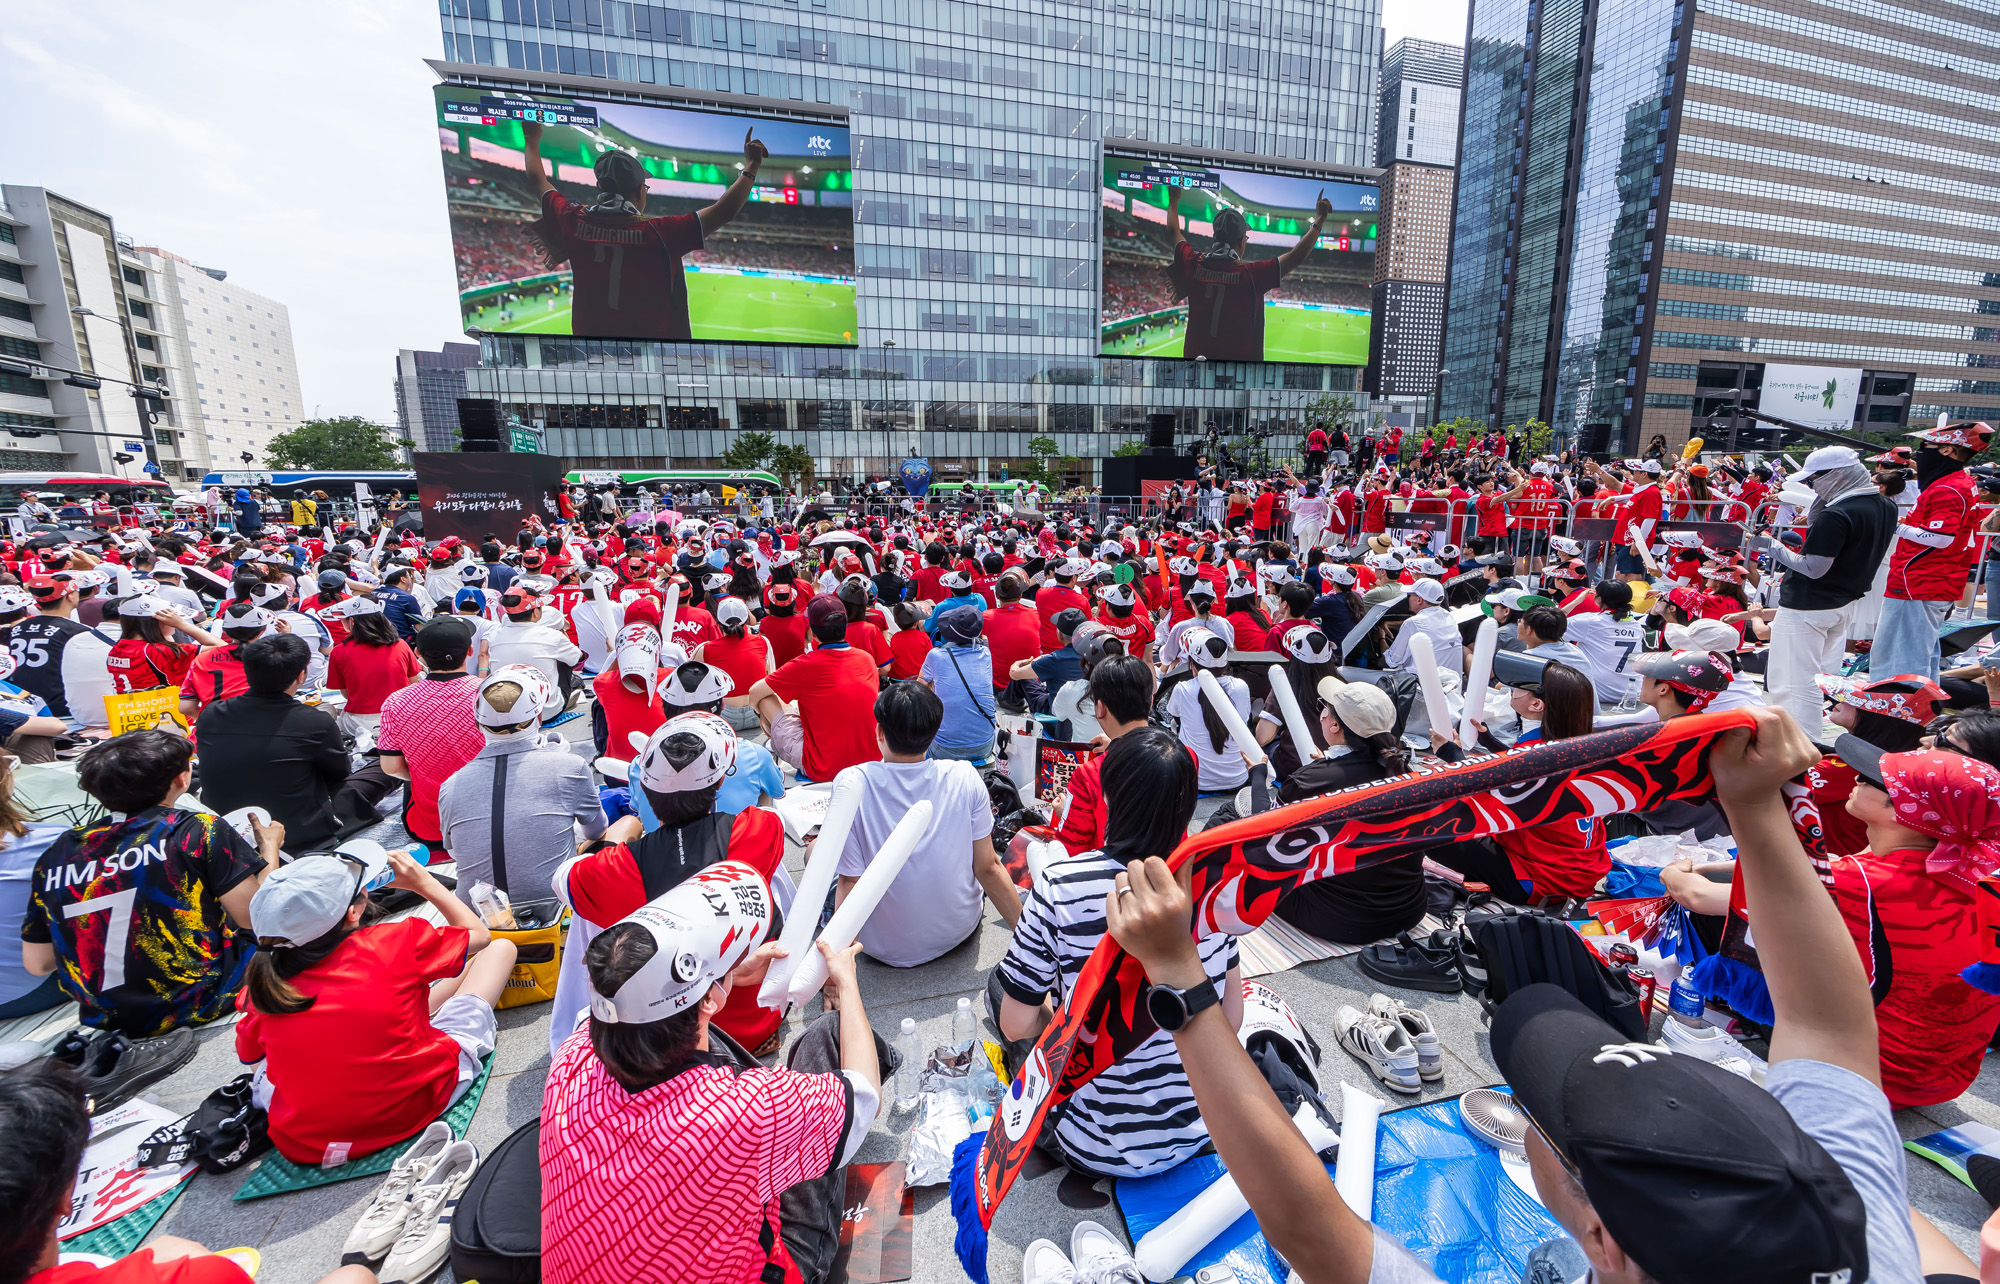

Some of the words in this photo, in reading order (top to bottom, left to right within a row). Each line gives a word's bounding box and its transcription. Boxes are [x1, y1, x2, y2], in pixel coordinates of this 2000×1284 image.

[461, 104, 478, 113] 45:00
[570, 116, 595, 125] 대한민국
[593, 243, 624, 311] 7
[1204, 284, 1226, 338] 7
[432, 500, 451, 513] 우리
[452, 500, 468, 512] 모두
[498, 500, 523, 511] 승리를
[672, 620, 702, 635] OAR!
[1614, 629, 1634, 638] SON
[10, 638, 50, 668] 35
[1614, 641, 1636, 673] 7
[118, 702, 134, 710] I'M
[136, 696, 174, 708] SHORT
[127, 712, 158, 722] LOVE
[121, 722, 146, 734] ICE
[44, 860, 97, 892] HM
[102, 839, 168, 877] SON
[702, 893, 730, 916] KT
[62, 887, 138, 992] 7
[674, 996, 688, 1008] kt
[80, 1166, 98, 1184] T
